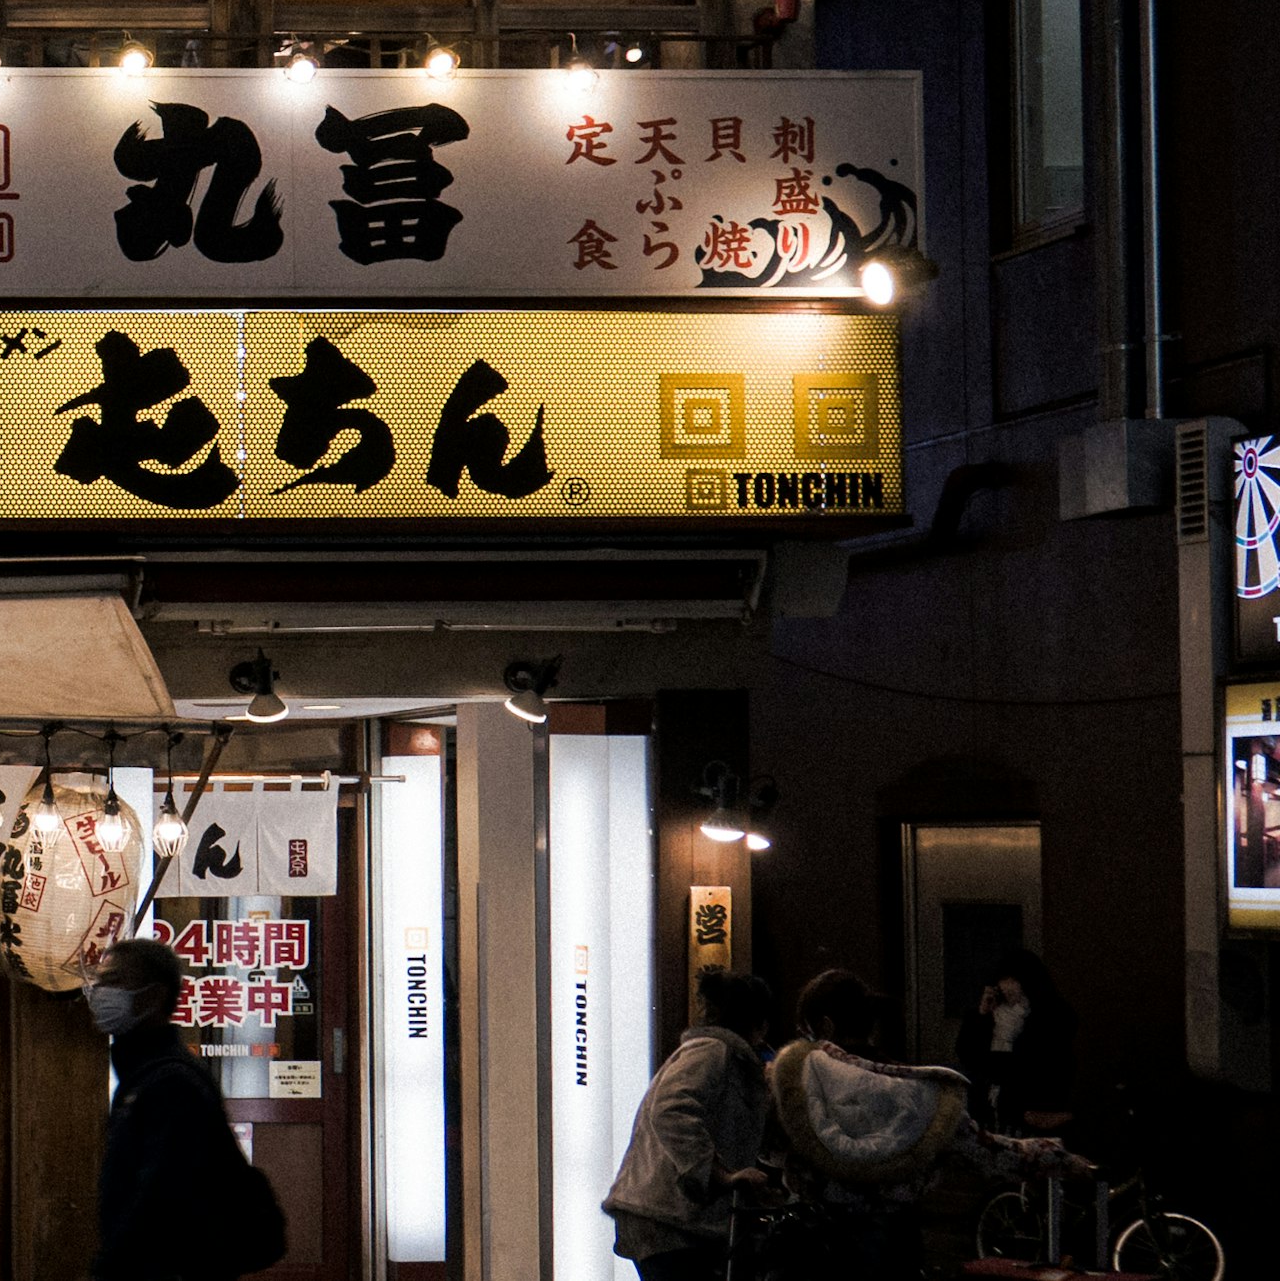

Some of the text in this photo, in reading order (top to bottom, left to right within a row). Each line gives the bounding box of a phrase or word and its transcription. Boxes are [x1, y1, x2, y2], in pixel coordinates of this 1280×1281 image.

[564, 114, 619, 272] 定食
[634, 118, 686, 271] 天ぷら
[770, 115, 821, 268] 刺盛り
[735, 471, 884, 509] TONCHIN
[200, 1044, 249, 1057] TONCHIN
[406, 953, 428, 1040] TONCHIN
[574, 978, 589, 1087] TONCHIN
